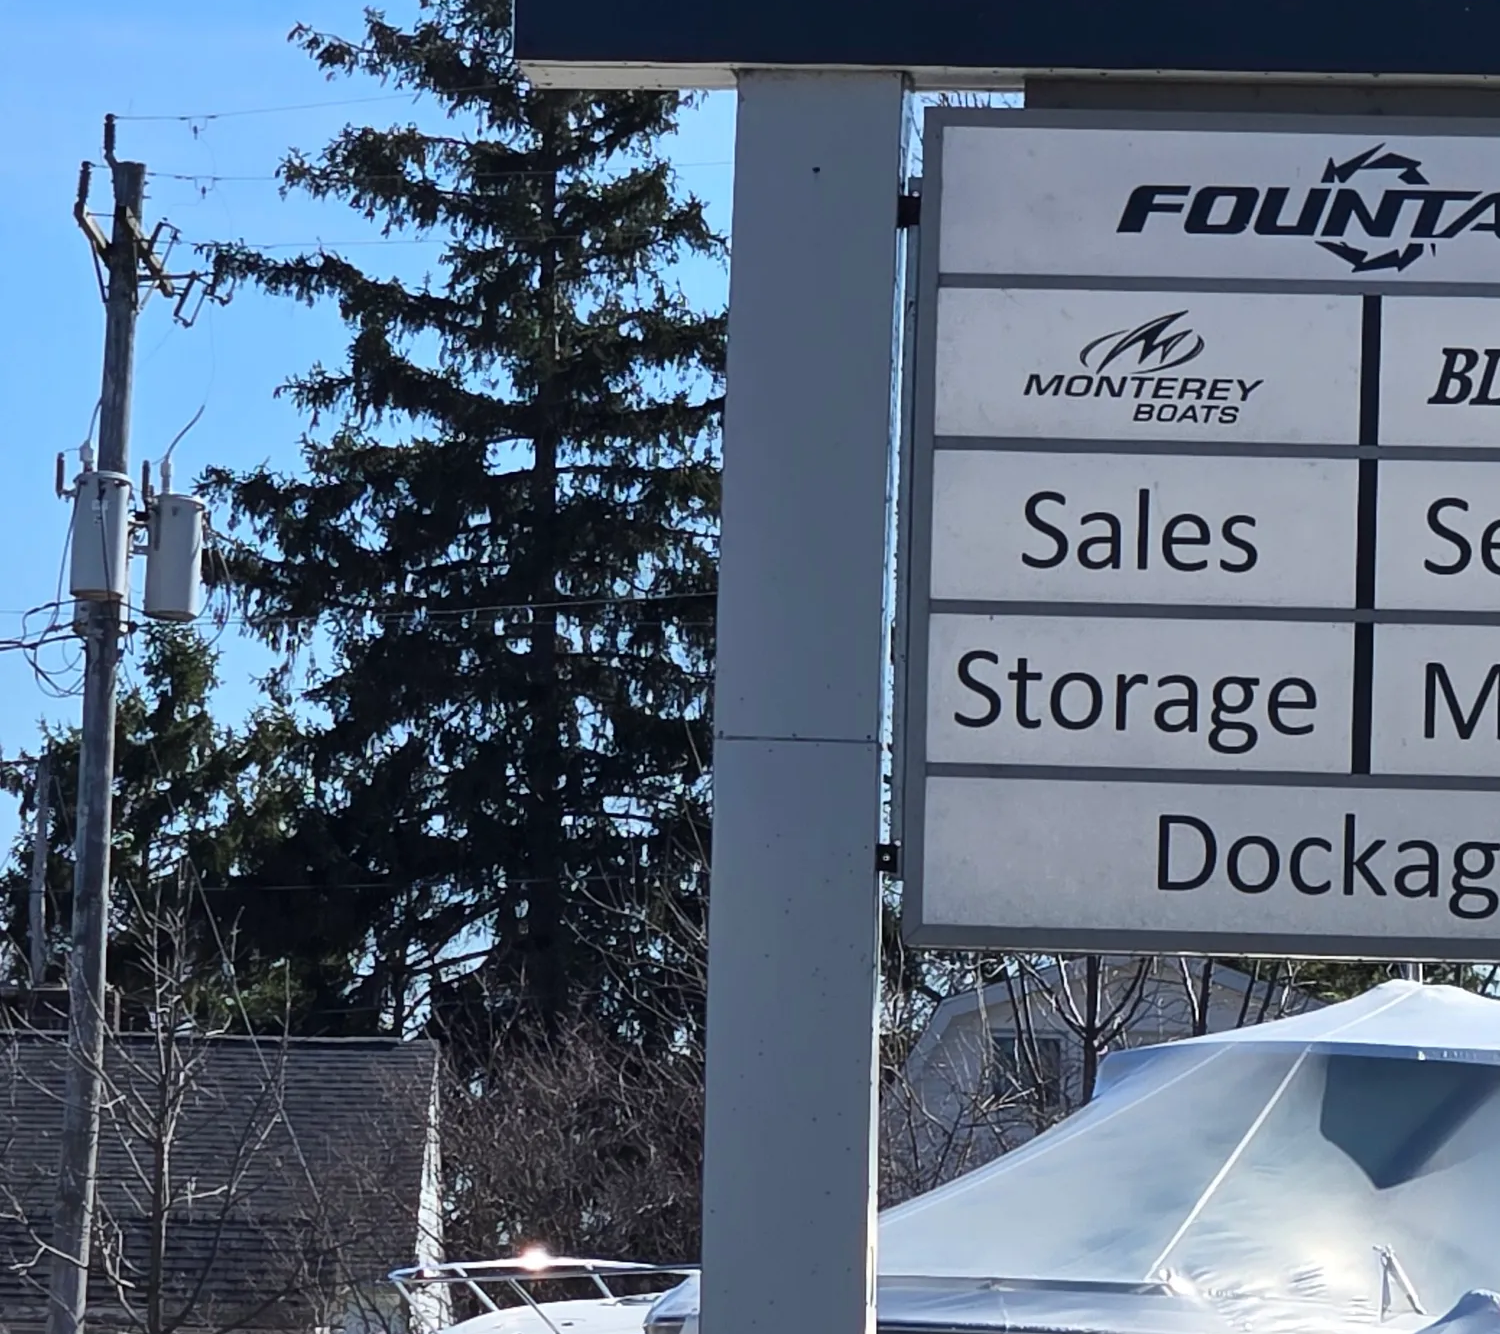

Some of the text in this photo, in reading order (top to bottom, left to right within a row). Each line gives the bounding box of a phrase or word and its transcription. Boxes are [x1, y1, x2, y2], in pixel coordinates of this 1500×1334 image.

[1023, 374, 1264, 402] MONTEREY
[1133, 403, 1240, 425] BOATS
[1021, 488, 1258, 573] Sales
[954, 650, 1317, 755] Storage
